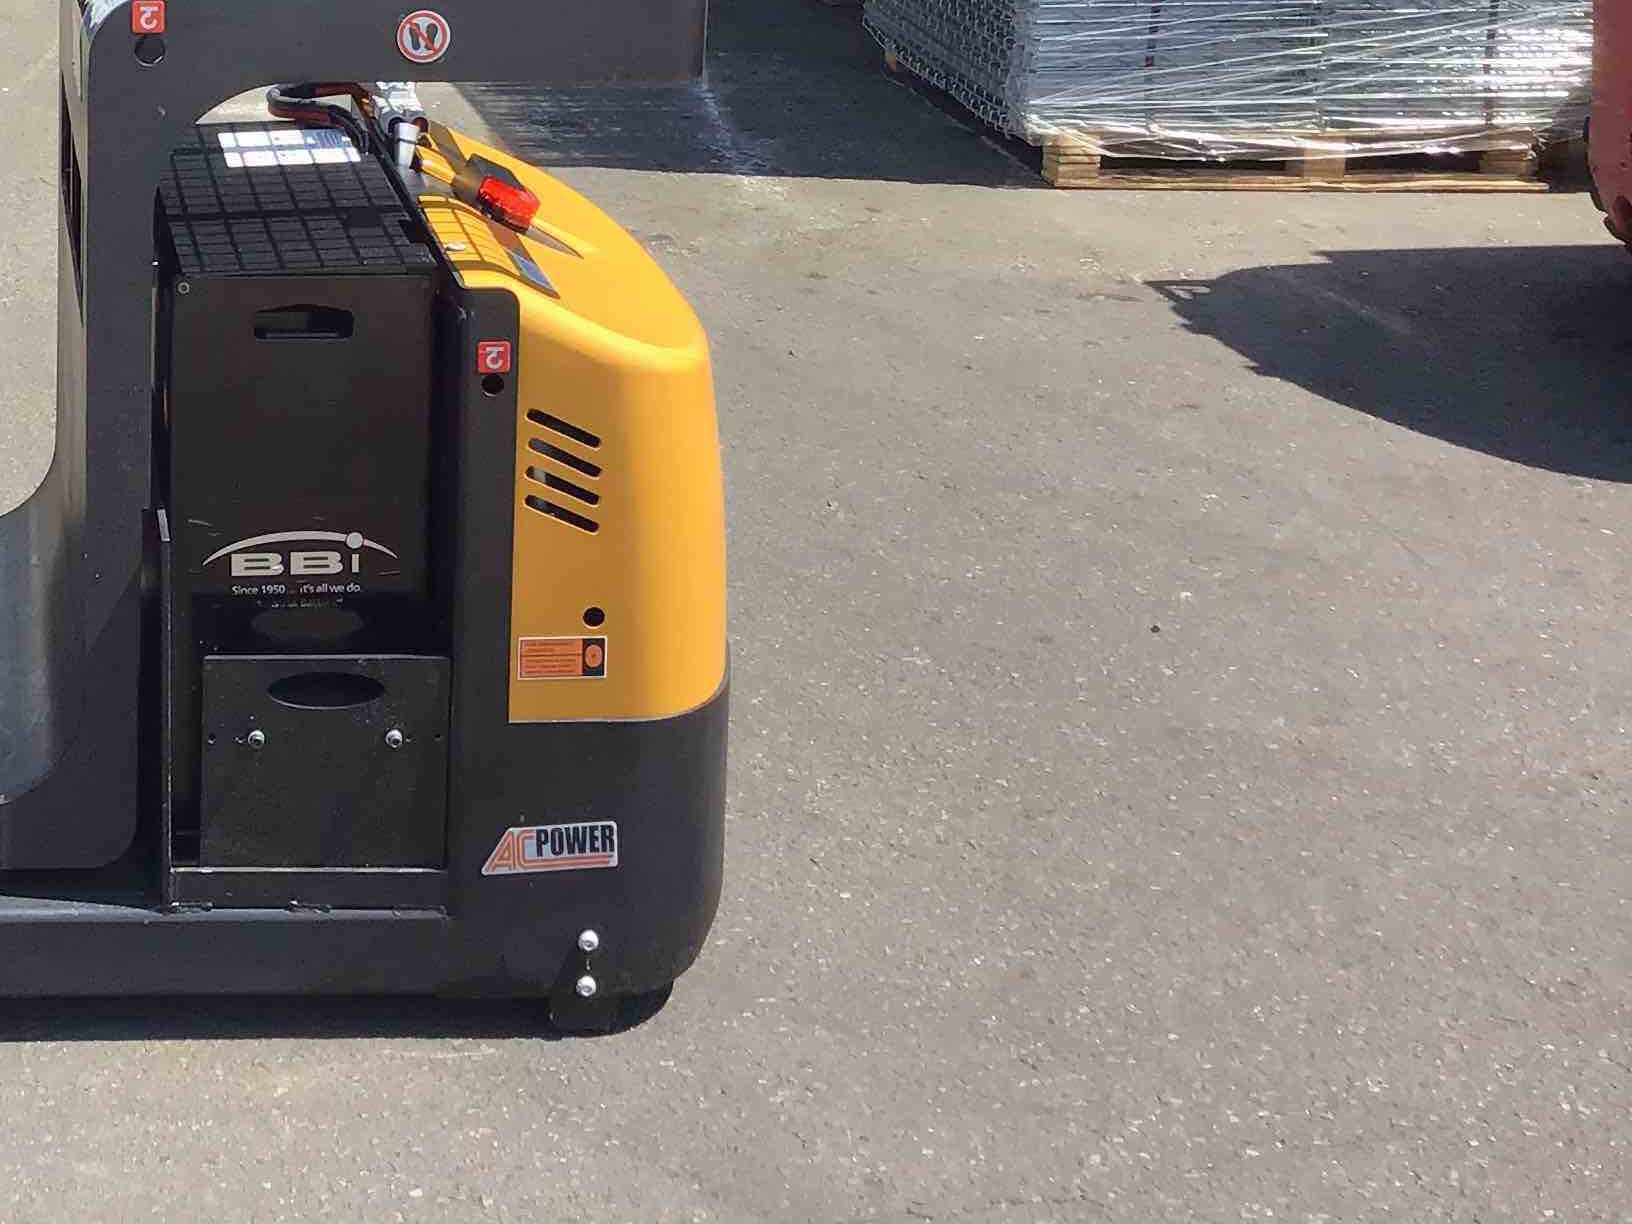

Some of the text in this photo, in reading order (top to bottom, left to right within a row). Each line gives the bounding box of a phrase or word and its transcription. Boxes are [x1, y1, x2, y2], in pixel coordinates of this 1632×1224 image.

[231, 584, 259, 596] Since
[261, 584, 286, 594] 1950
[316, 583, 328, 593] all
[329, 584, 345, 593] we
[534, 825, 616, 857] POWER
